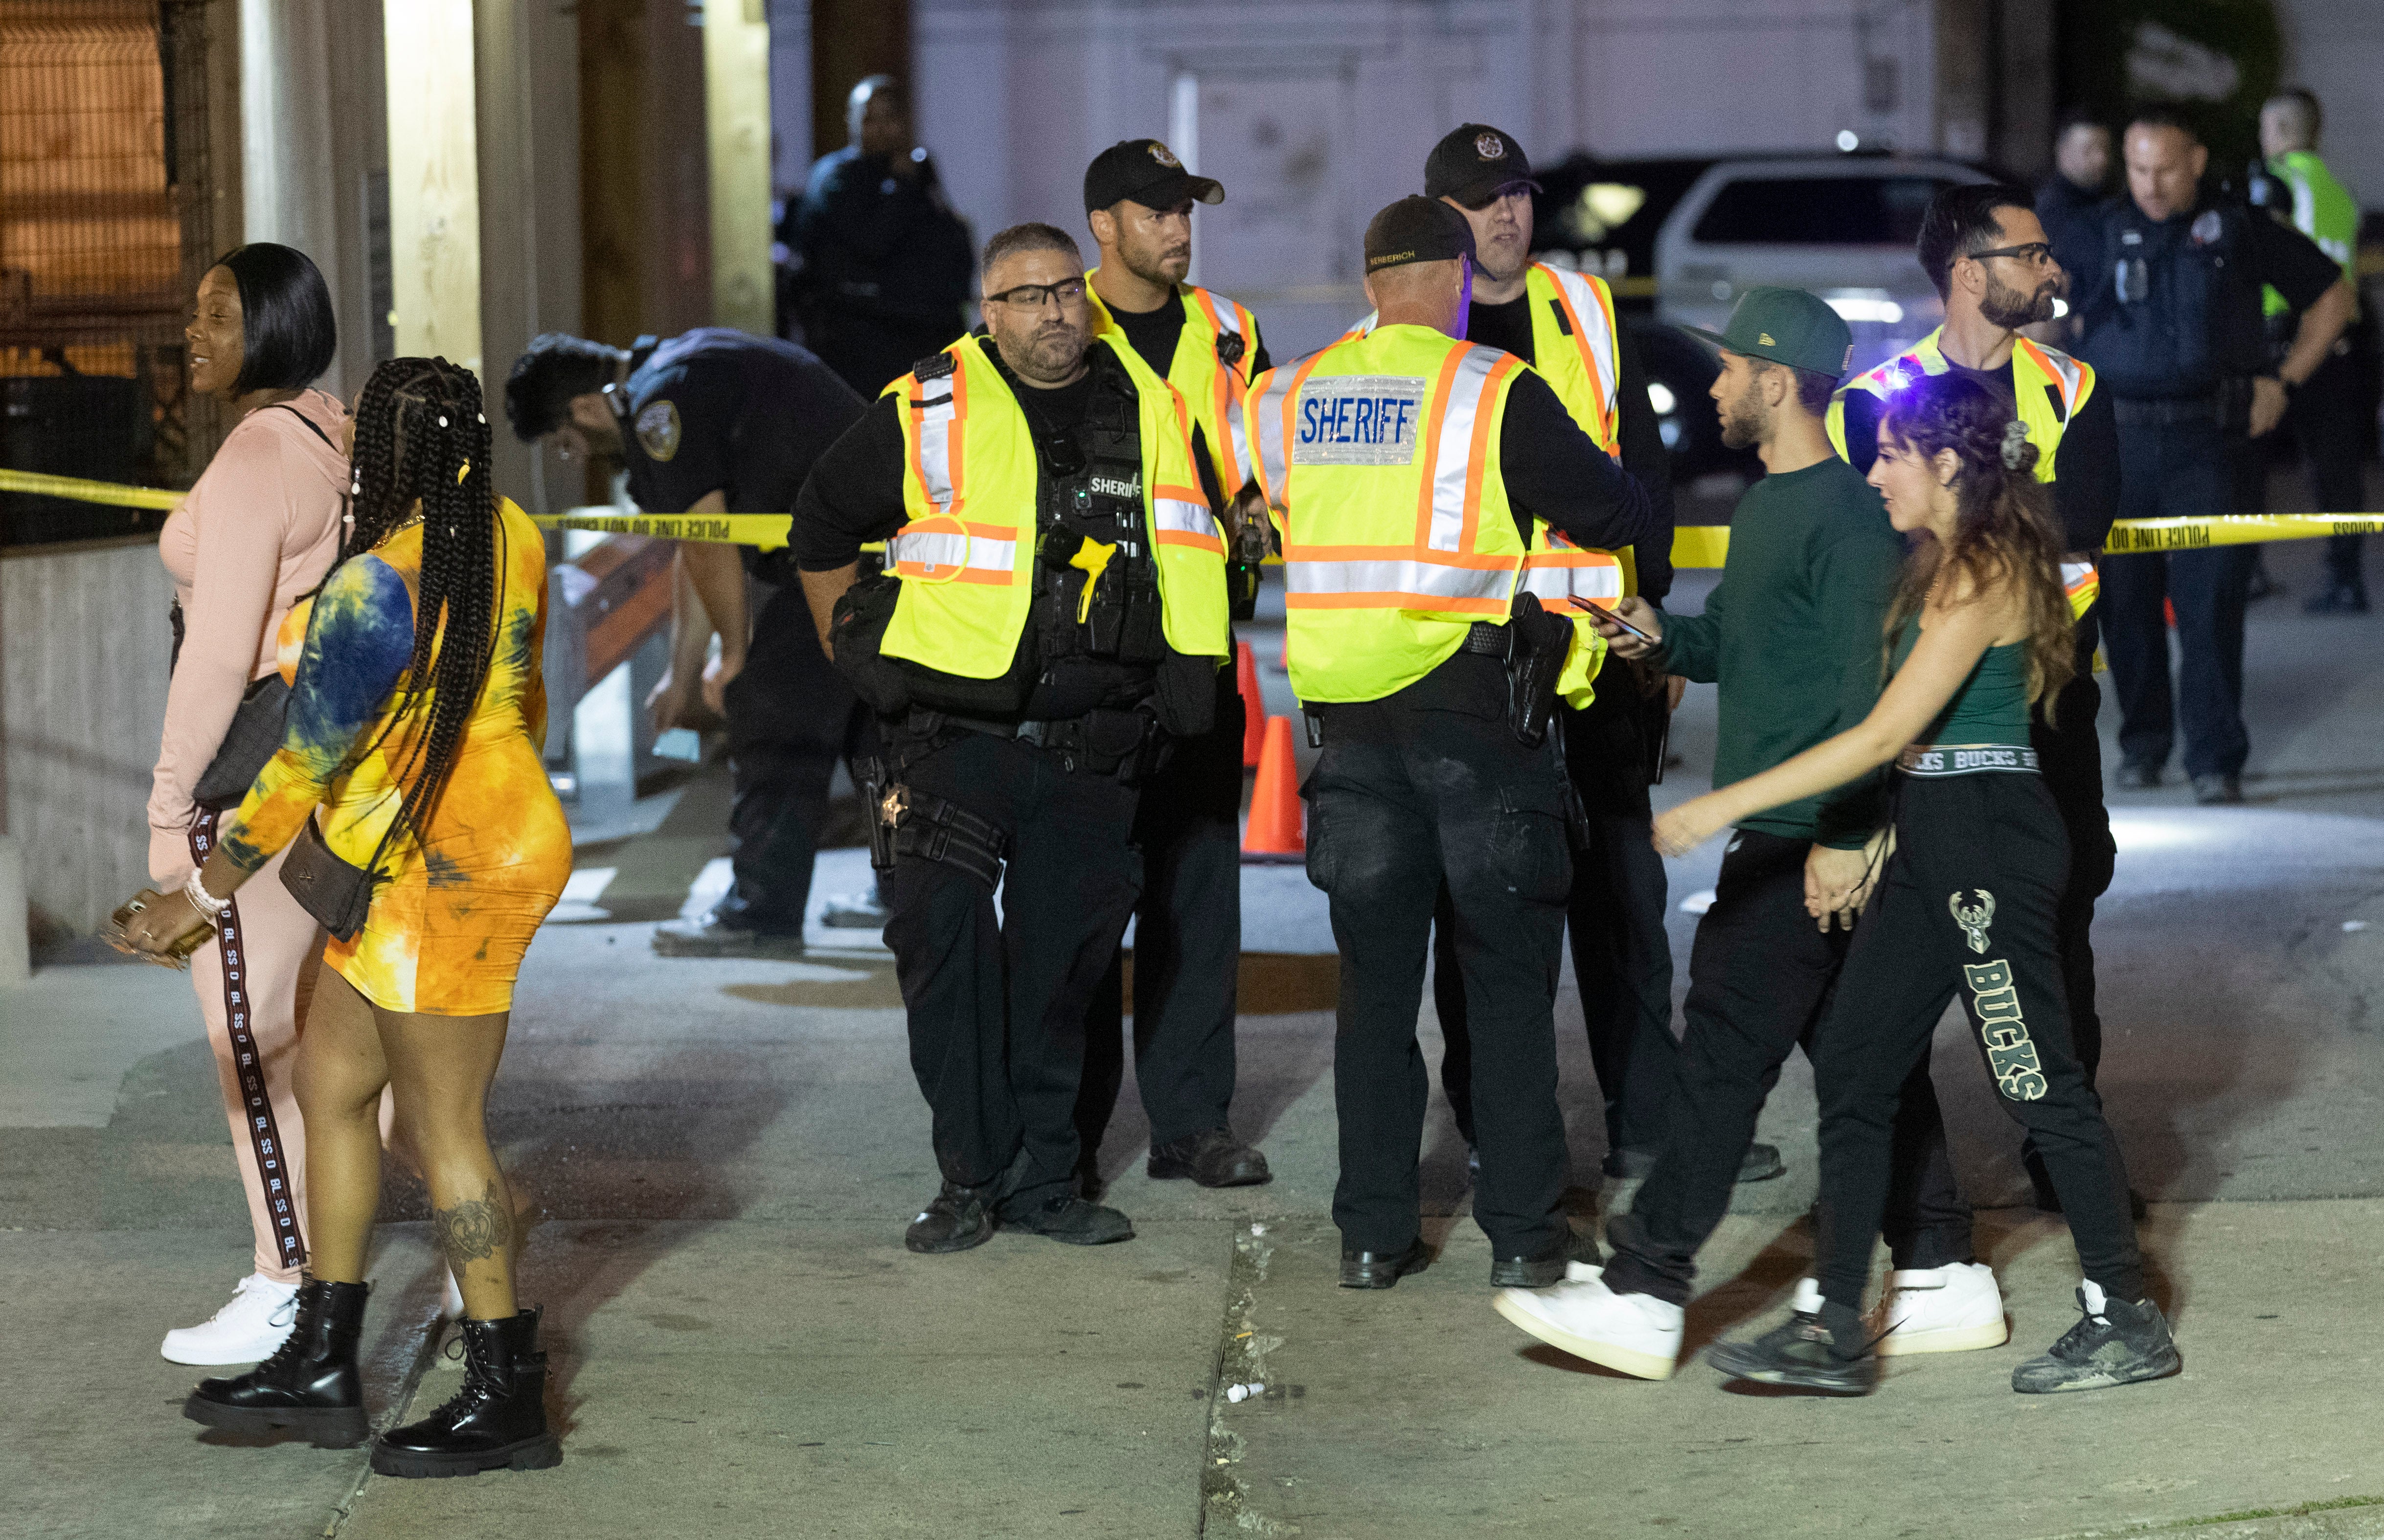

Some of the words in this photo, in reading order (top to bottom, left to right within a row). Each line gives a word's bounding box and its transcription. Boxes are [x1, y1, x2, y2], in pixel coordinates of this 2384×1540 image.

[1301, 398, 1415, 444] SHERIFF
[633, 519, 649, 535] DO
[656, 520, 682, 537] LINE
[688, 520, 730, 539] POLICE
[2135, 527, 2161, 549] LINE
[2168, 524, 2210, 547] POLICE
[2112, 527, 2129, 550] DO
[1954, 750, 2017, 769] BUCKS
[1963, 959, 2048, 1101] BUCKS
